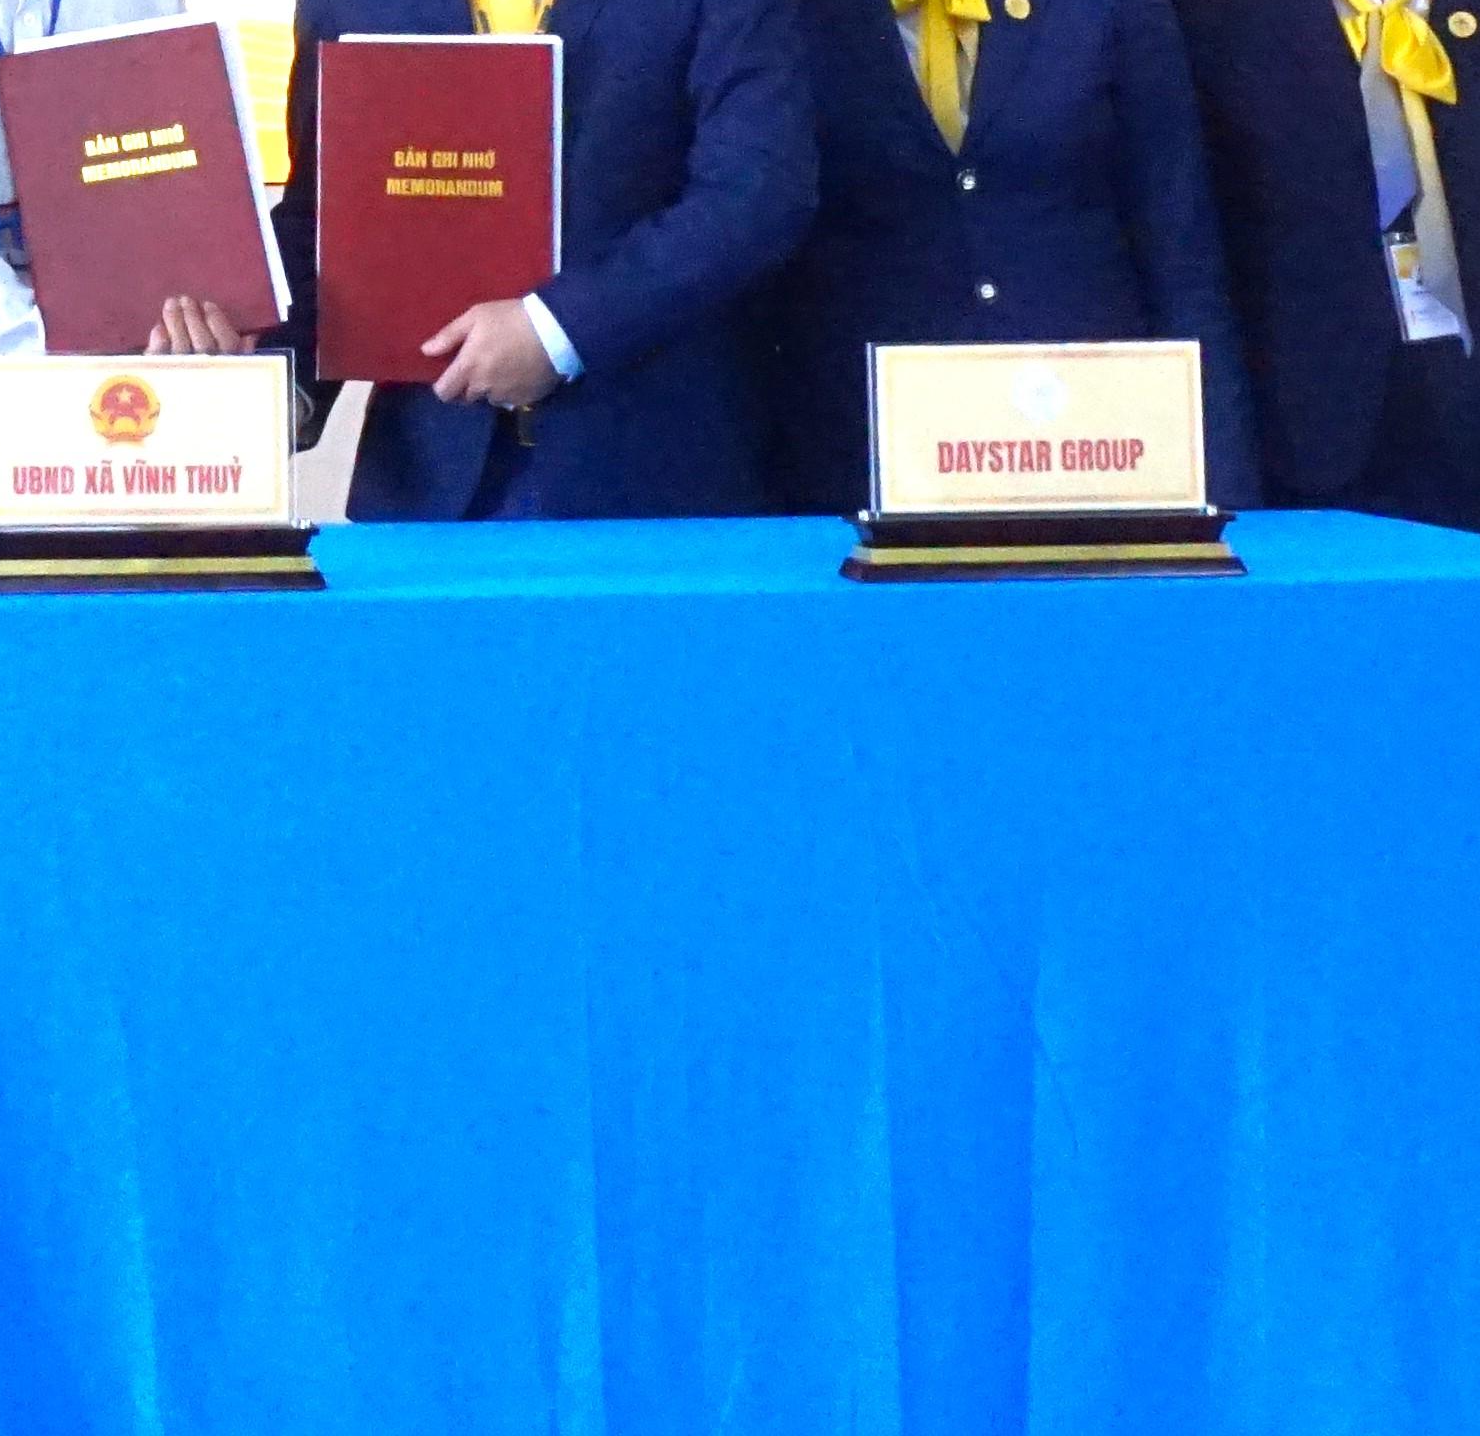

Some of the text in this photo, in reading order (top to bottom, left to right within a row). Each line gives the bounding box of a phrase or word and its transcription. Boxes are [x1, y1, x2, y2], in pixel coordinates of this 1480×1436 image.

[81, 149, 198, 184] MEMORANDUM
[386, 178, 504, 197] MEMORANDUM
[937, 437, 1146, 474] DAYSTAR GROUP
[12, 454, 243, 496] UBND XÃ VĨNH THUỶ
